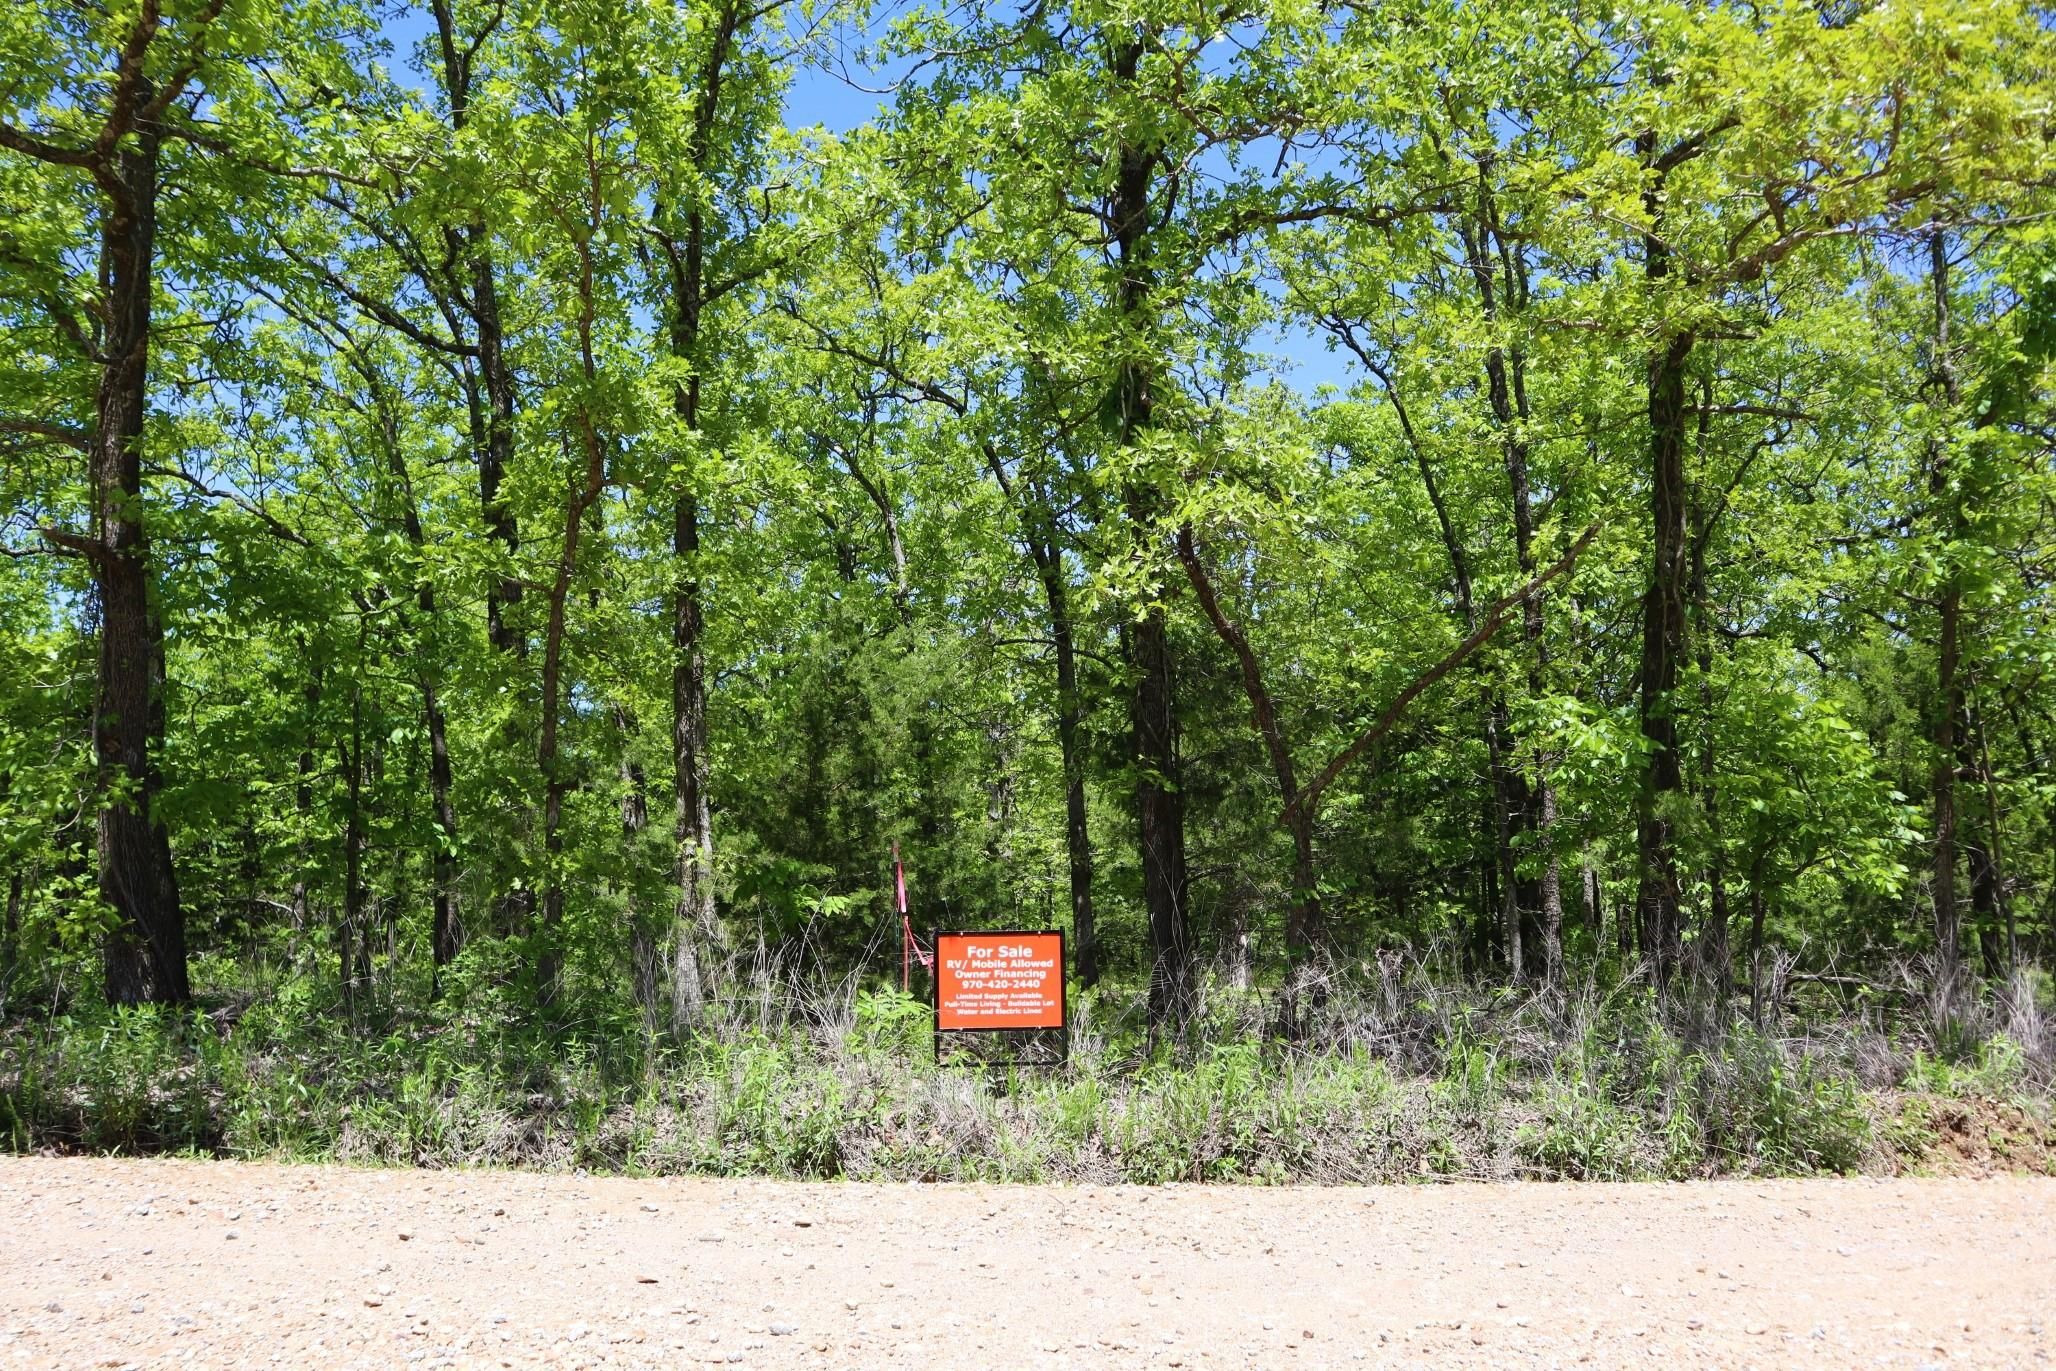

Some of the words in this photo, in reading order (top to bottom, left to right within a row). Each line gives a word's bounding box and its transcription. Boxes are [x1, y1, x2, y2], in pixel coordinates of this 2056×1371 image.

[967, 946, 993, 958] For
[998, 945, 1032, 957] Sale
[947, 960, 967, 970] RV/
[972, 960, 1007, 968] Mobile
[994, 970, 1046, 979] Financing
[962, 980, 1040, 988] 970-420-2440
